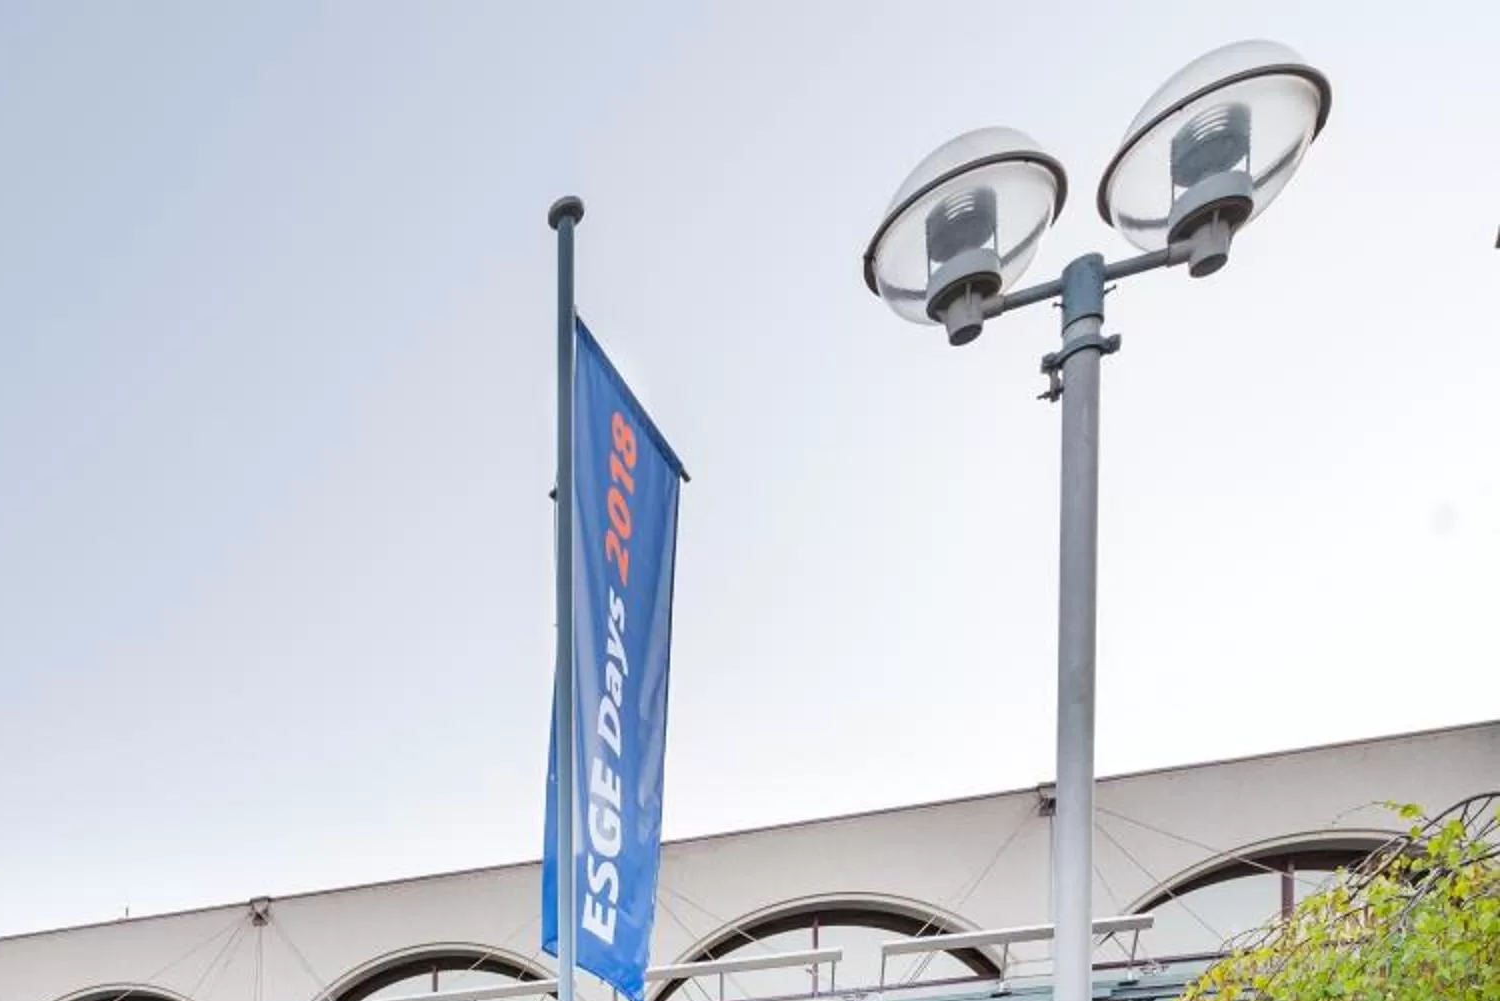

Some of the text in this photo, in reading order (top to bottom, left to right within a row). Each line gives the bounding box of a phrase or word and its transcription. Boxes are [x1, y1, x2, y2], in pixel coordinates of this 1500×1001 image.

[582, 410, 639, 944] ESGE Days 2018
